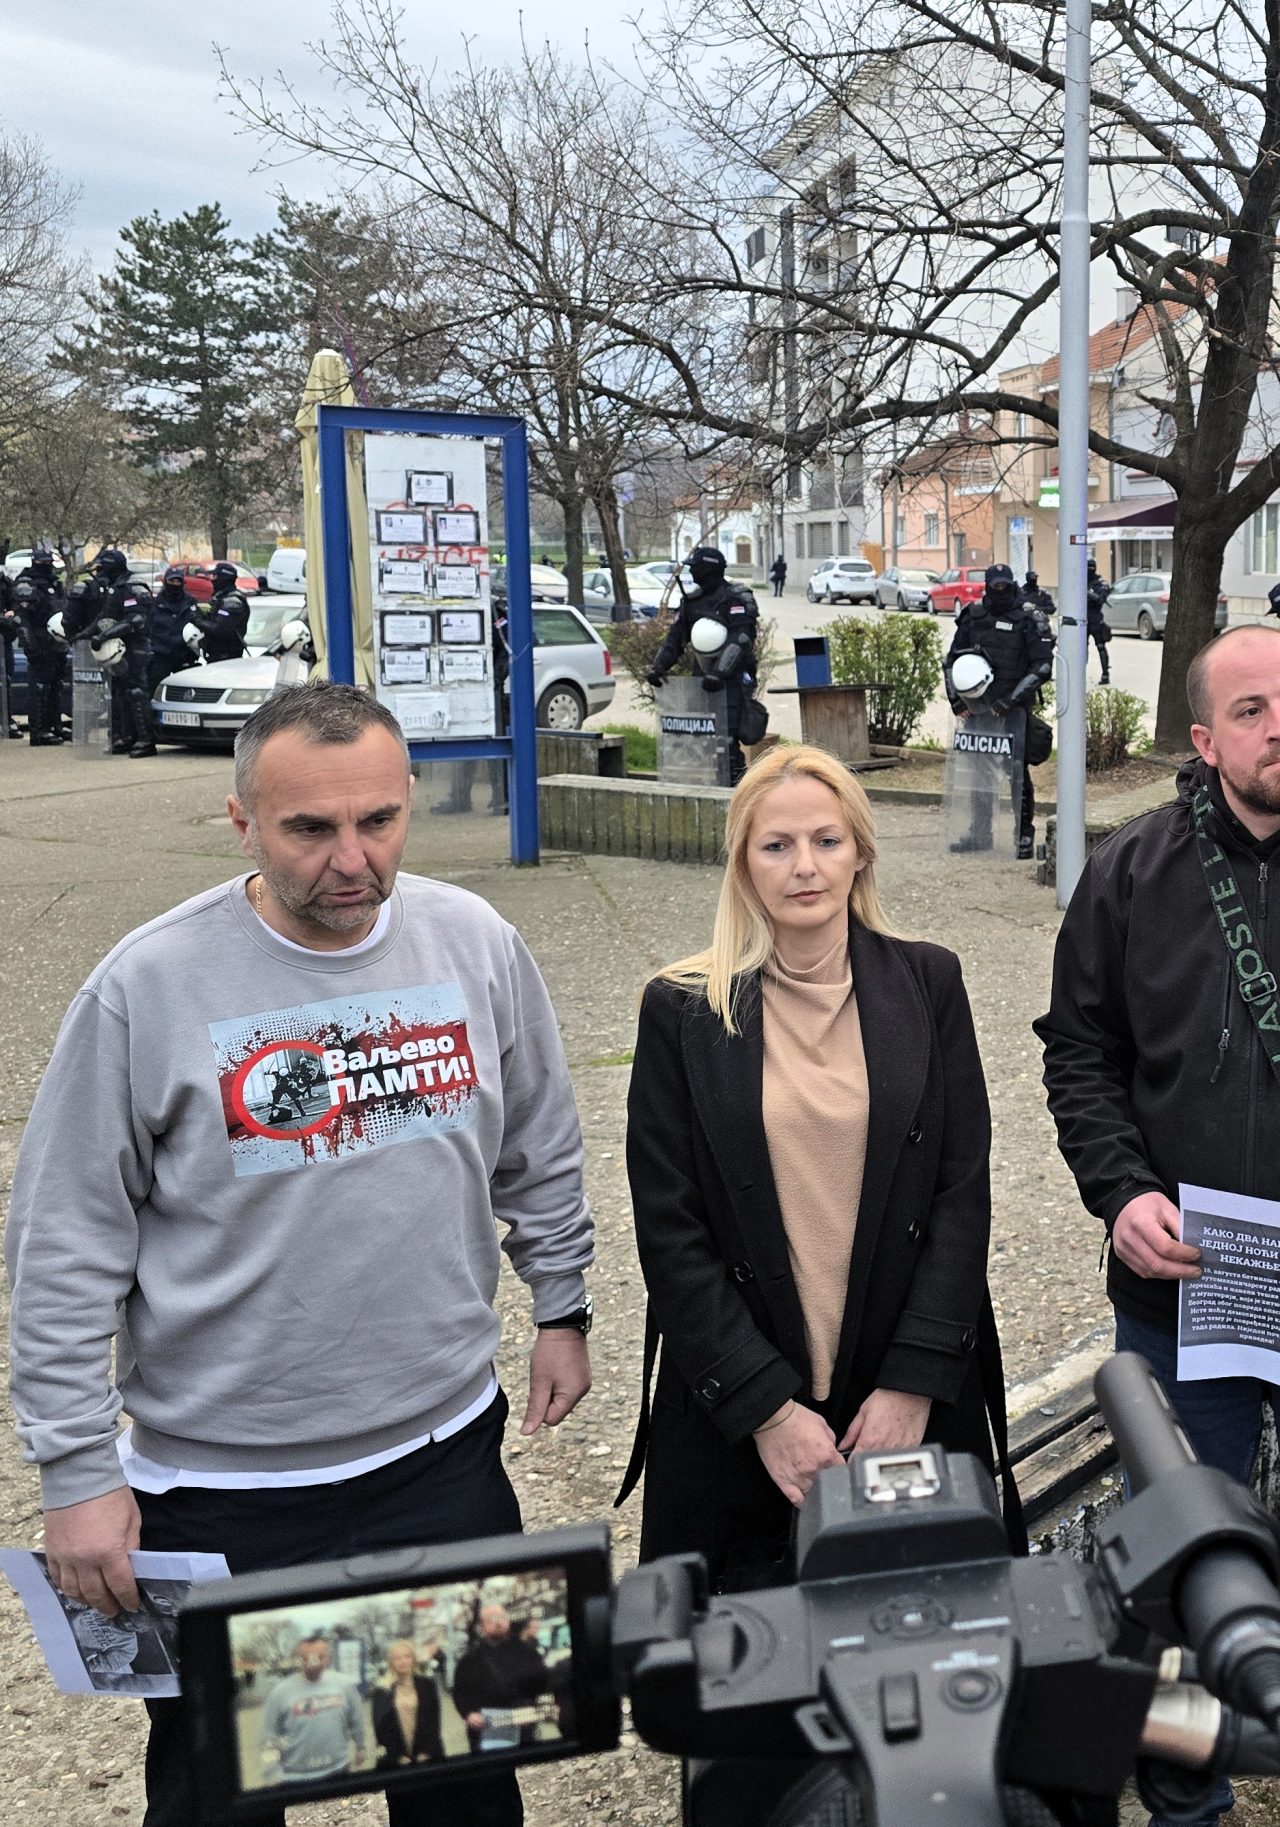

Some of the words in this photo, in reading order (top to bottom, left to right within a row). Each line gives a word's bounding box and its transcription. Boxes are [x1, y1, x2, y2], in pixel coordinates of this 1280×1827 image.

[662, 717, 715, 734] ПОЛИЦИЈА
[954, 732, 1012, 755] POLICIJA
[322, 1035, 455, 1077] Ваљево
[327, 1055, 472, 1107] ПАМТИ!
[1203, 1227, 1234, 1238] КАКО
[1236, 1233, 1259, 1244] ДВА
[1199, 1239, 1242, 1252] ЈЕДНОЈ
[1245, 1246, 1278, 1259] НОЋИ
